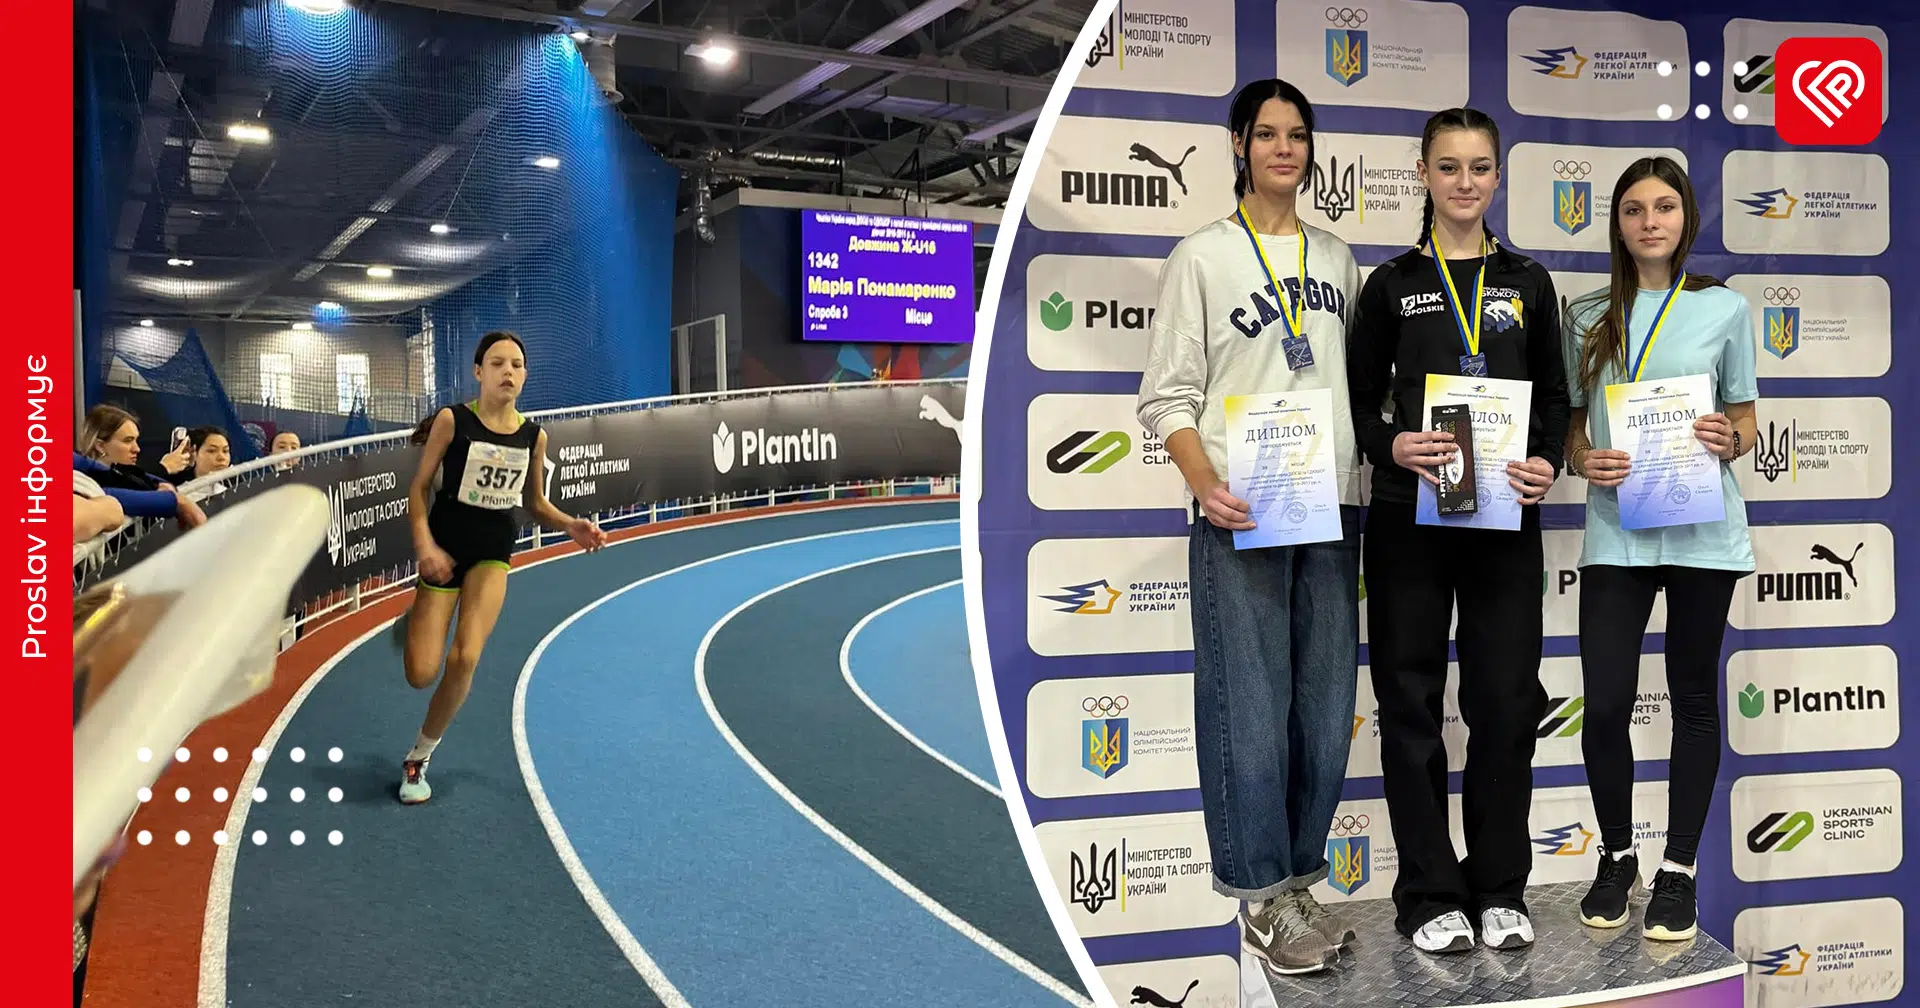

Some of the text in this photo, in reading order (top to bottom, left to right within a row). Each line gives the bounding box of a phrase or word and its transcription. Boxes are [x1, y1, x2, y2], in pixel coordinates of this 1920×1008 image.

[1124, 12, 1188, 28] МІНІСТЕРСТВО
[1124, 29, 1212, 46] МОЛОДІ ТА СПОРТУ
[1124, 45, 1164, 58] УКРАЇНИ
[1594, 52, 1647, 61] ФЕДЕРАЦІЯ
[1594, 61, 1677, 70] ЛЕГКОЇ АТЛЕТИ
[1594, 71, 1635, 80] УКРАЇНИ
[1364, 184, 1398, 197] МОЛОДІ
[1400, 185, 1411, 196] ТА
[1804, 192, 1850, 201] ФЕДЕРАЦІЯ
[1364, 199, 1400, 211] УКРАЇНИ
[1804, 201, 1877, 210] ЛЕГКОЇ АТЛЕТИКИ
[1804, 210, 1841, 219] УКРАЇНИ
[848, 236, 900, 253] Довжина
[807, 252, 840, 269] 1342
[808, 276, 956, 301] Марія Понамаренко
[1416, 292, 1443, 305] LDK
[808, 304, 933, 326] Спроба 3 Місце
[1404, 305, 1445, 317] OPOLSKIE
[1469, 410, 1512, 425] ПЛОМ
[1627, 408, 1697, 429] ДИПЛОМ
[1245, 424, 1317, 443] ДИПЛОМ
[1797, 430, 1849, 441] МІНІСТЕРСТВО
[559, 443, 604, 463] ФЕДЕРАЦІЯ
[741, 427, 837, 467] PlantIn
[1797, 444, 1869, 456] МОЛОДІ ТА СПОРТУ
[560, 458, 630, 481] ЛЕГКОЇ АТЛЕТИКИ
[1797, 458, 1830, 470] УКРАЇНИ
[476, 465, 523, 490] 357
[344, 471, 396, 500] МІНІСТЕРСТВО
[560, 480, 596, 500] УКРАЇНИ
[345, 506, 374, 533] МОЛОДІ
[374, 504, 386, 522] ТА
[346, 537, 377, 566] УКРАЇНИ
[1129, 581, 1188, 591] ФЕДЕРАЦІЯ
[1129, 591, 1167, 601] ЛЕГКОЇ
[1129, 602, 1176, 612] УКРАЇНИ
[1774, 685, 1885, 714] PlantIn
[1133, 727, 1191, 737] НАЦІОНАЛЬНИЙ
[1133, 736, 1188, 746] ОЛІМПІЙСЬКИЙ
[1133, 745, 1194, 755] КОМІТЕТ УКРАЇНИ
[1823, 805, 1893, 818] UKRAINIAN
[1823, 818, 1874, 829] SPORTS
[1823, 830, 1865, 840] CLINIC
[1127, 847, 1192, 863] МІНІСТЕРСТВО
[1127, 866, 1164, 880] МОЛОДІ
[1166, 865, 1178, 876] ТА
[1127, 882, 1167, 896] УКРАЇНИ
[1817, 942, 1864, 953] ФЕДЕРАЦІЯ
[1817, 949, 1893, 962] ЛЕГКОЇ АТЛЕТИКИ
[1817, 962, 1854, 972] УКРАЇНИ
